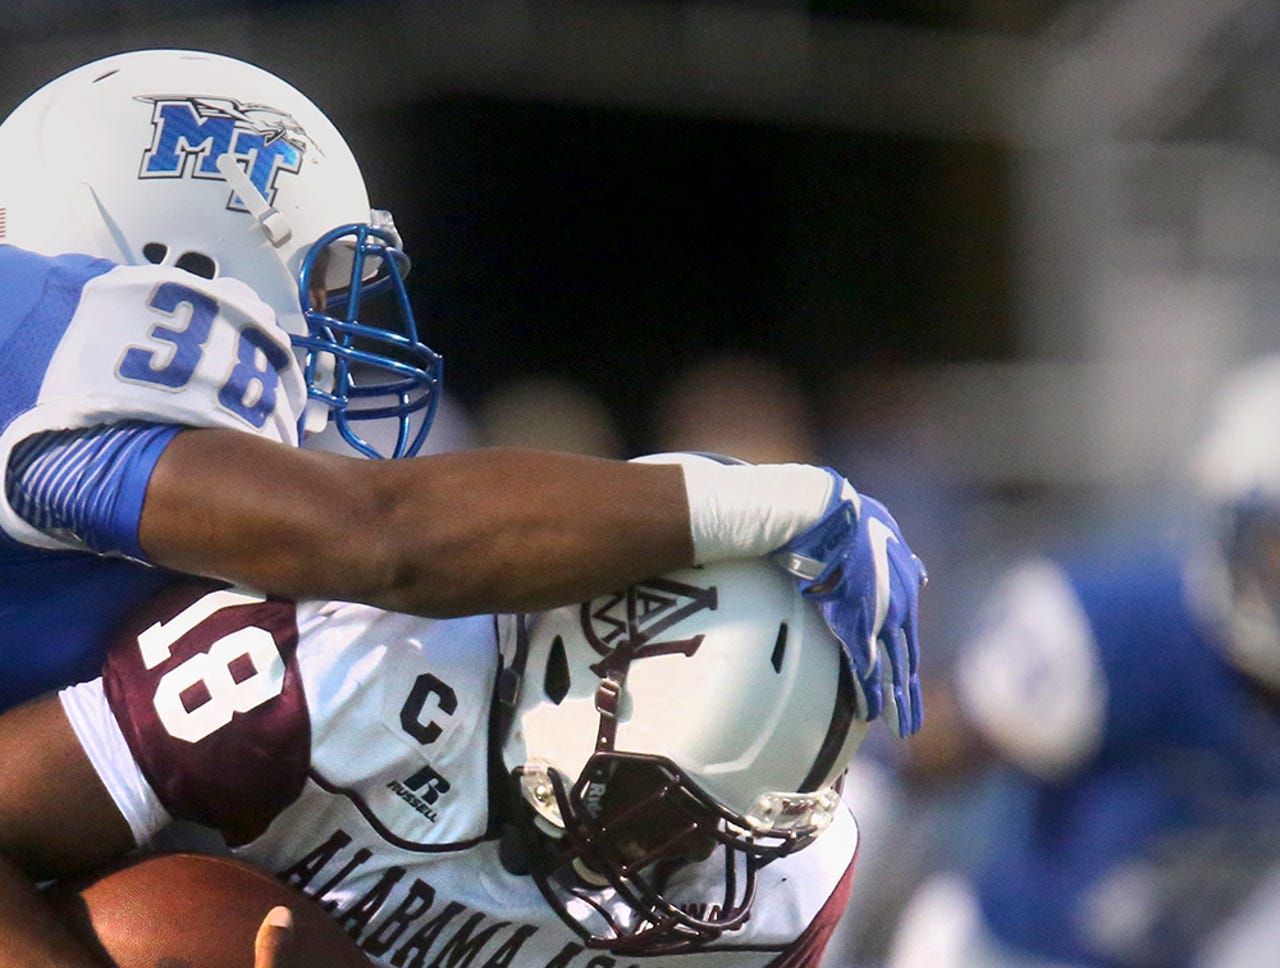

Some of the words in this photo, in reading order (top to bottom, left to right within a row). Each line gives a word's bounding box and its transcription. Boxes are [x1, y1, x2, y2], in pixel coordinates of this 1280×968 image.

[137, 589, 287, 744] 18
[399, 672, 459, 746] C
[386, 780, 438, 823] RUSSELL
